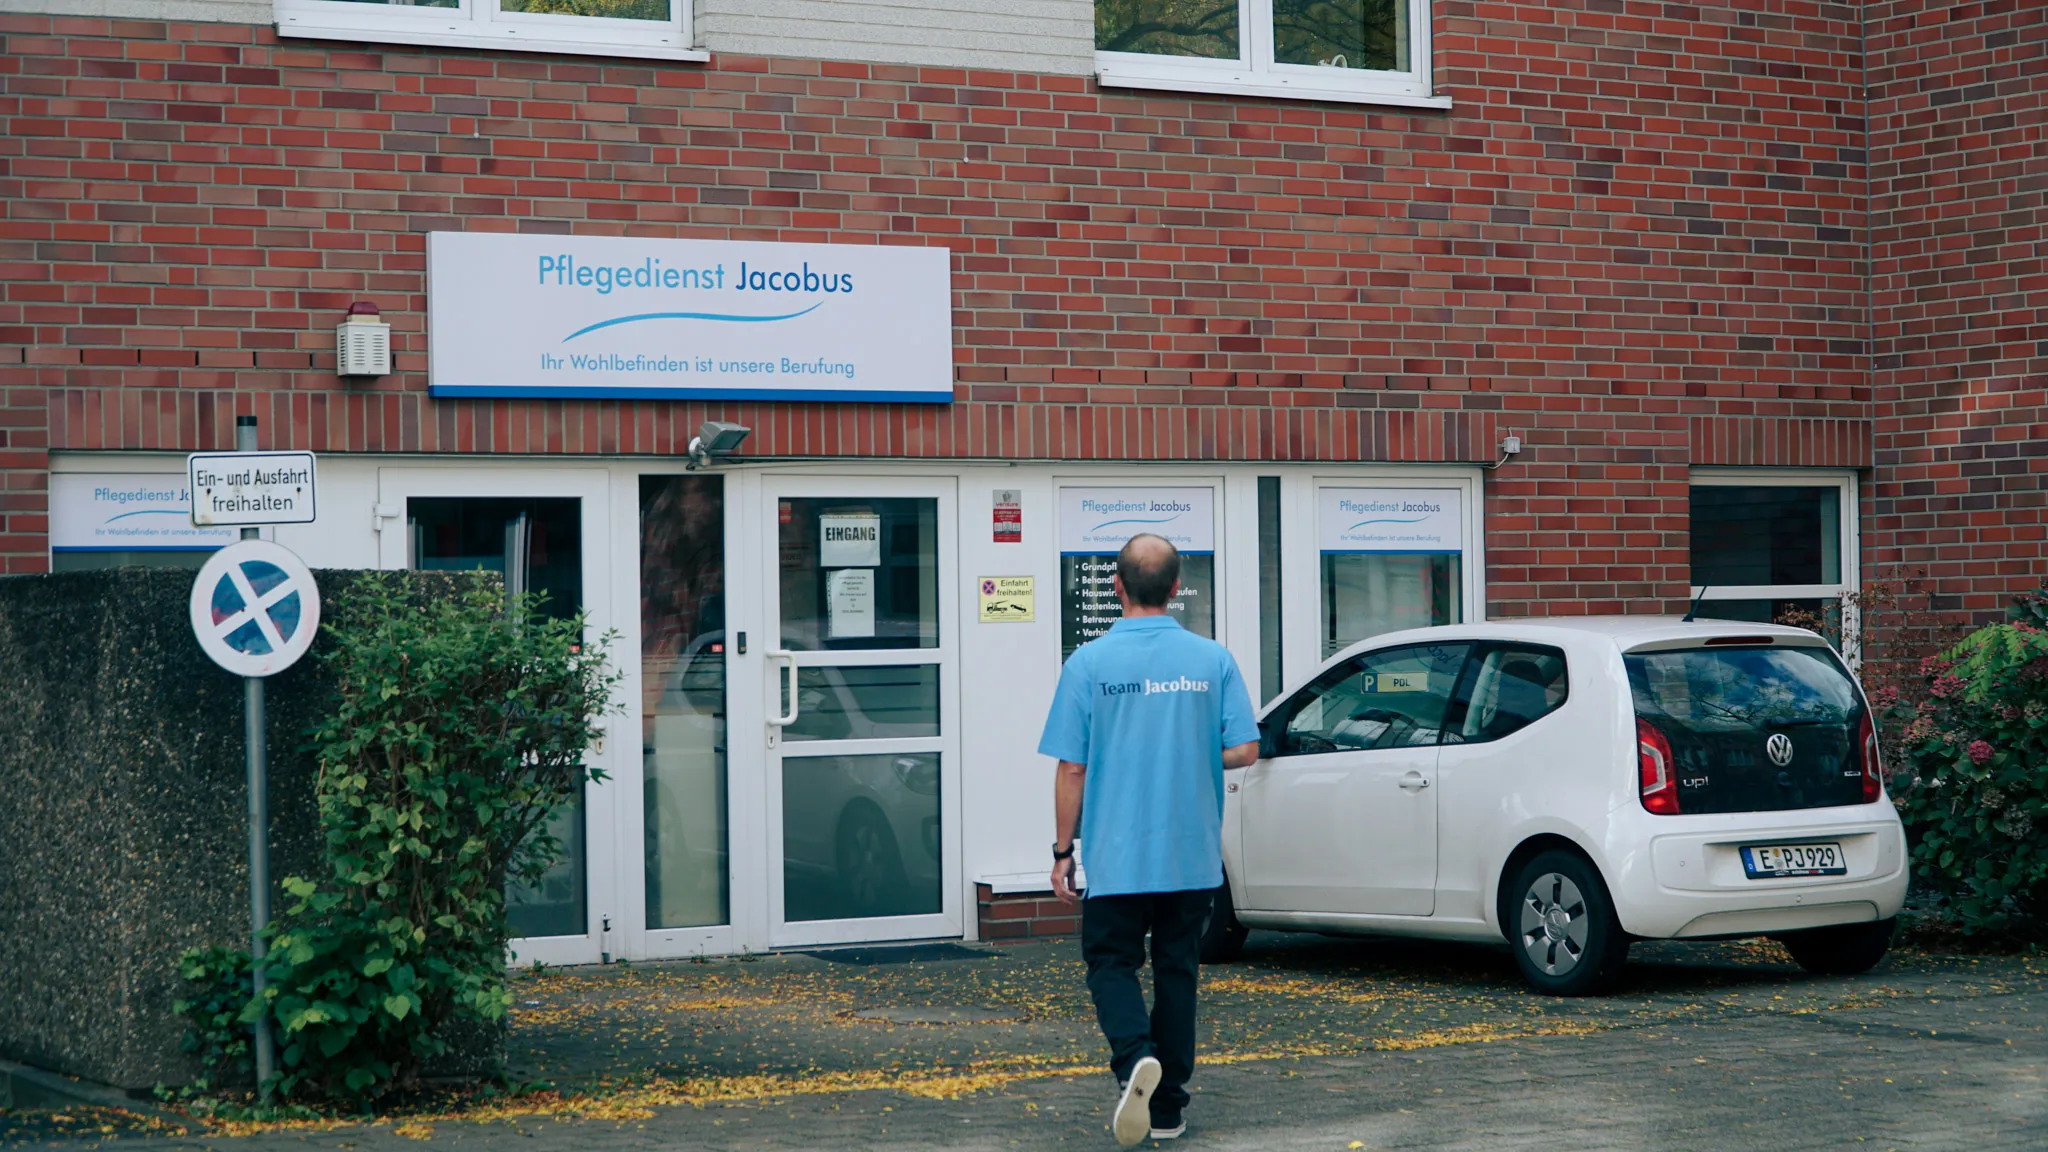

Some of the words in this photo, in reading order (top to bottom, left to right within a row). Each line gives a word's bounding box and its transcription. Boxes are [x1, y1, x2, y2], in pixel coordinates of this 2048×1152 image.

[538, 254, 725, 294] Pflegedienst
[735, 261, 853, 293] Jacobus
[541, 353, 564, 370] Ihr
[570, 354, 689, 372] Wohlbefinden
[695, 356, 713, 372] ist
[719, 358, 775, 373] unsere
[781, 358, 854, 378] Berufung
[197, 470, 223, 486] Ein-
[227, 469, 250, 486] und
[254, 468, 308, 485] Ausfahrt
[95, 487, 175, 504] Pflegedienst
[213, 494, 293, 512] freihalten
[1082, 500, 1146, 514] Pflegedienst
[1149, 500, 1191, 512] Jacobus
[1340, 500, 1399, 514] Pflegedienst
[1402, 500, 1440, 512] Jacobus
[95, 528, 106, 536] Ihr
[108, 528, 159, 536] Wohlbefinden
[825, 527, 876, 541] EINGANG
[1081, 562, 1118, 573] Grundpfl
[1082, 575, 1115, 584] Behandl
[1082, 588, 1119, 597] Hauswir
[1099, 682, 1141, 696] Team
[1144, 675, 1209, 696] Jacobus
[1364, 676, 1374, 691] P
[1393, 678, 1411, 687] PDL
[1683, 775, 1709, 789] up!
[1760, 849, 1774, 869] E
